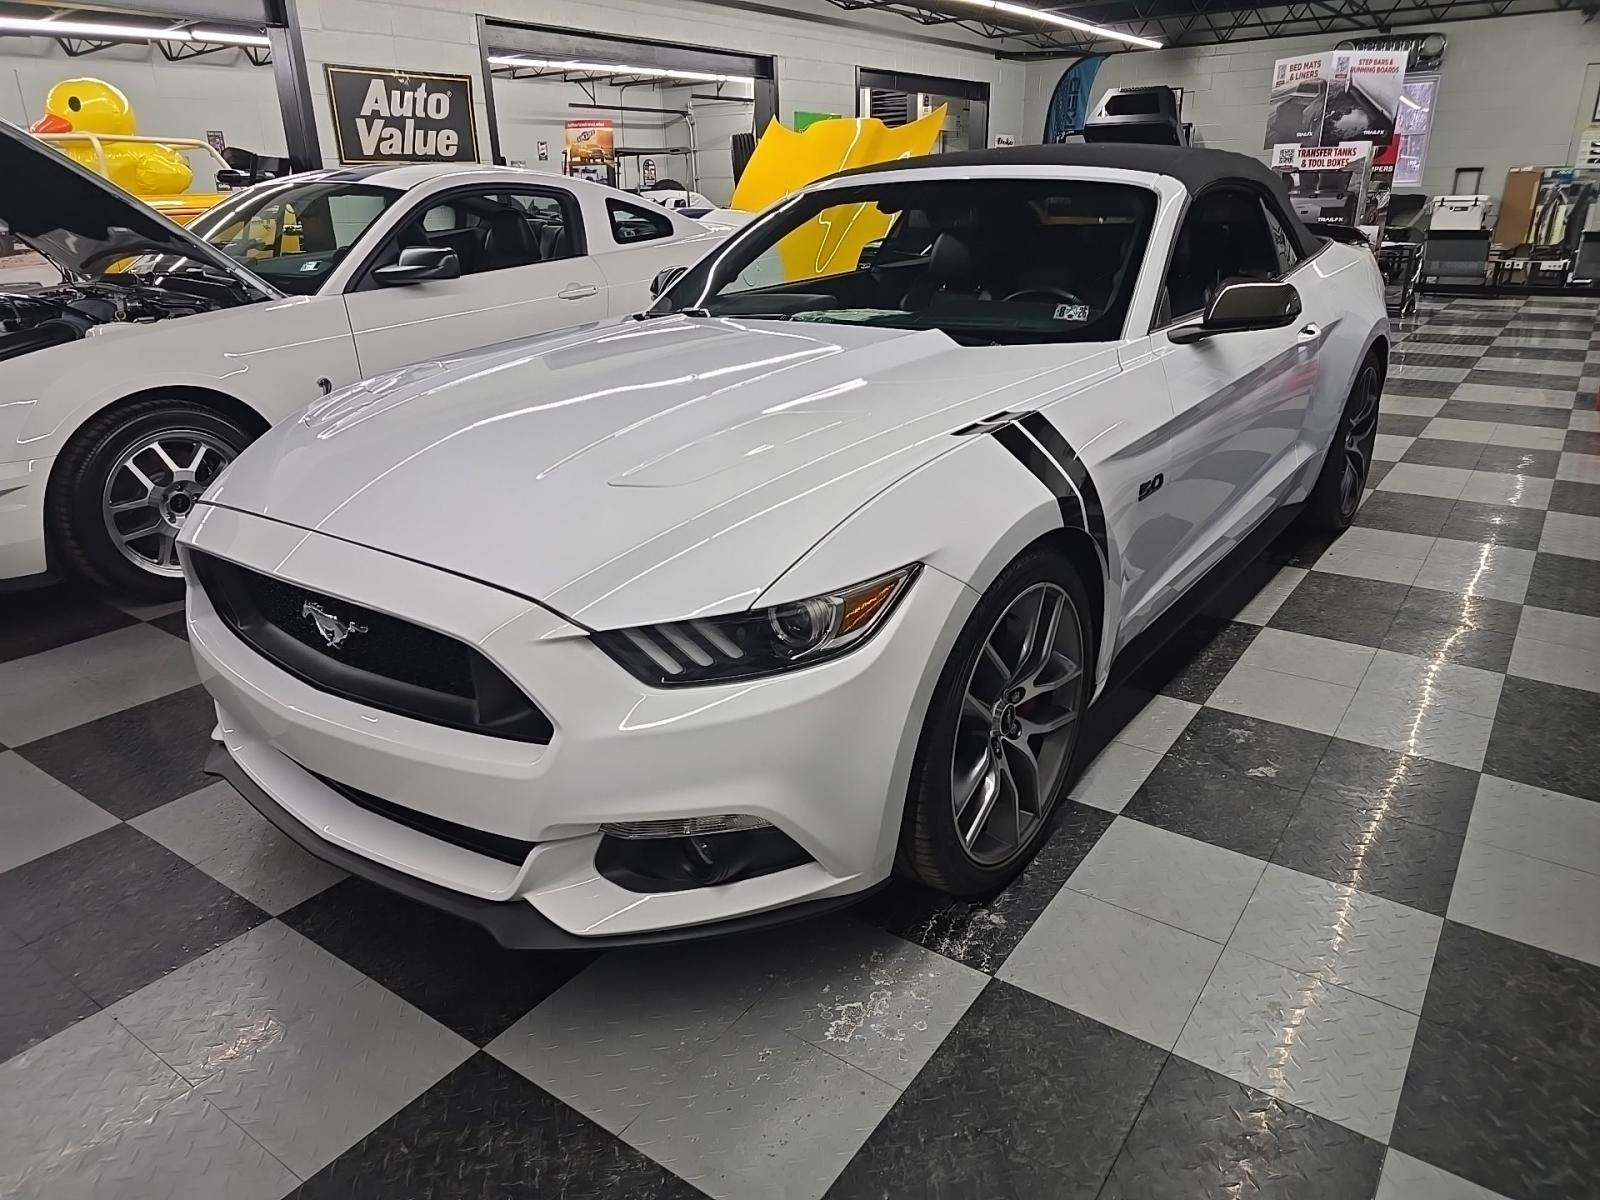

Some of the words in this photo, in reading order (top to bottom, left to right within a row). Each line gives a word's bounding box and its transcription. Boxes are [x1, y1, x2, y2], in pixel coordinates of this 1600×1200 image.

[1289, 63, 1302, 72] BED
[1303, 60, 1321, 70] MATS
[1376, 66, 1399, 74] BOARDS
[1295, 71, 1318, 80] LINERS
[360, 79, 450, 120] Auto
[355, 118, 459, 157] Value
[1298, 149, 1333, 158] TRANSFER
[1334, 148, 1357, 157] TANKS
[1308, 159, 1325, 168] TOOL
[1327, 158, 1350, 167] BOXES
